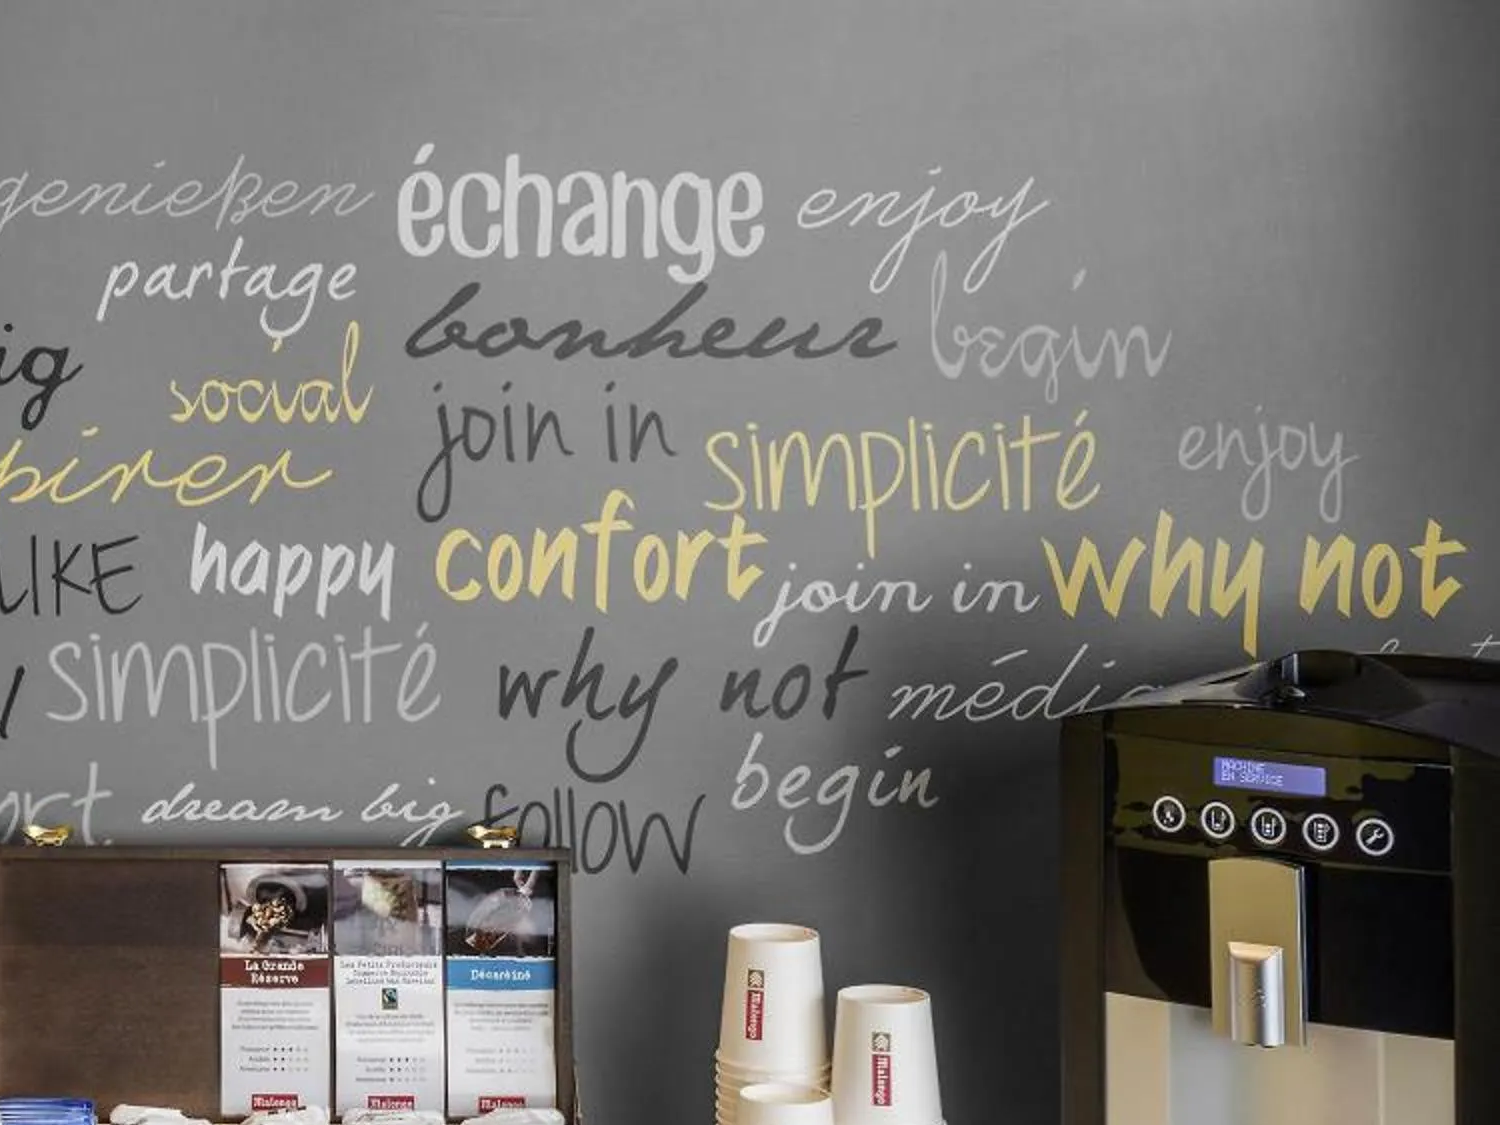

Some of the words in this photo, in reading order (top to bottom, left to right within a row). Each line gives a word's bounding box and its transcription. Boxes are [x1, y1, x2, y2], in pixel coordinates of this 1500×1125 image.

[397, 142, 765, 285] échange
[797, 166, 1052, 294] enjoy
[95, 236, 357, 340] partage
[404, 281, 898, 360] bonheur
[930, 250, 1172, 404] begin
[169, 320, 374, 424] social
[416, 381, 575, 523] join
[605, 381, 677, 463] in
[704, 409, 1101, 559] simplicité
[1177, 404, 1361, 523] enjoy
[190, 521, 395, 622] happy
[435, 488, 768, 614] confort
[753, 561, 932, 649] join
[953, 561, 1040, 613] in
[1041, 508, 1265, 657] why
[1300, 518, 1468, 620] not
[46, 621, 442, 771] simplicité
[499, 625, 679, 785] why
[719, 624, 868, 721] not
[141, 781, 344, 825] dream
[361, 778, 465, 847] big
[730, 730, 939, 856] begin
